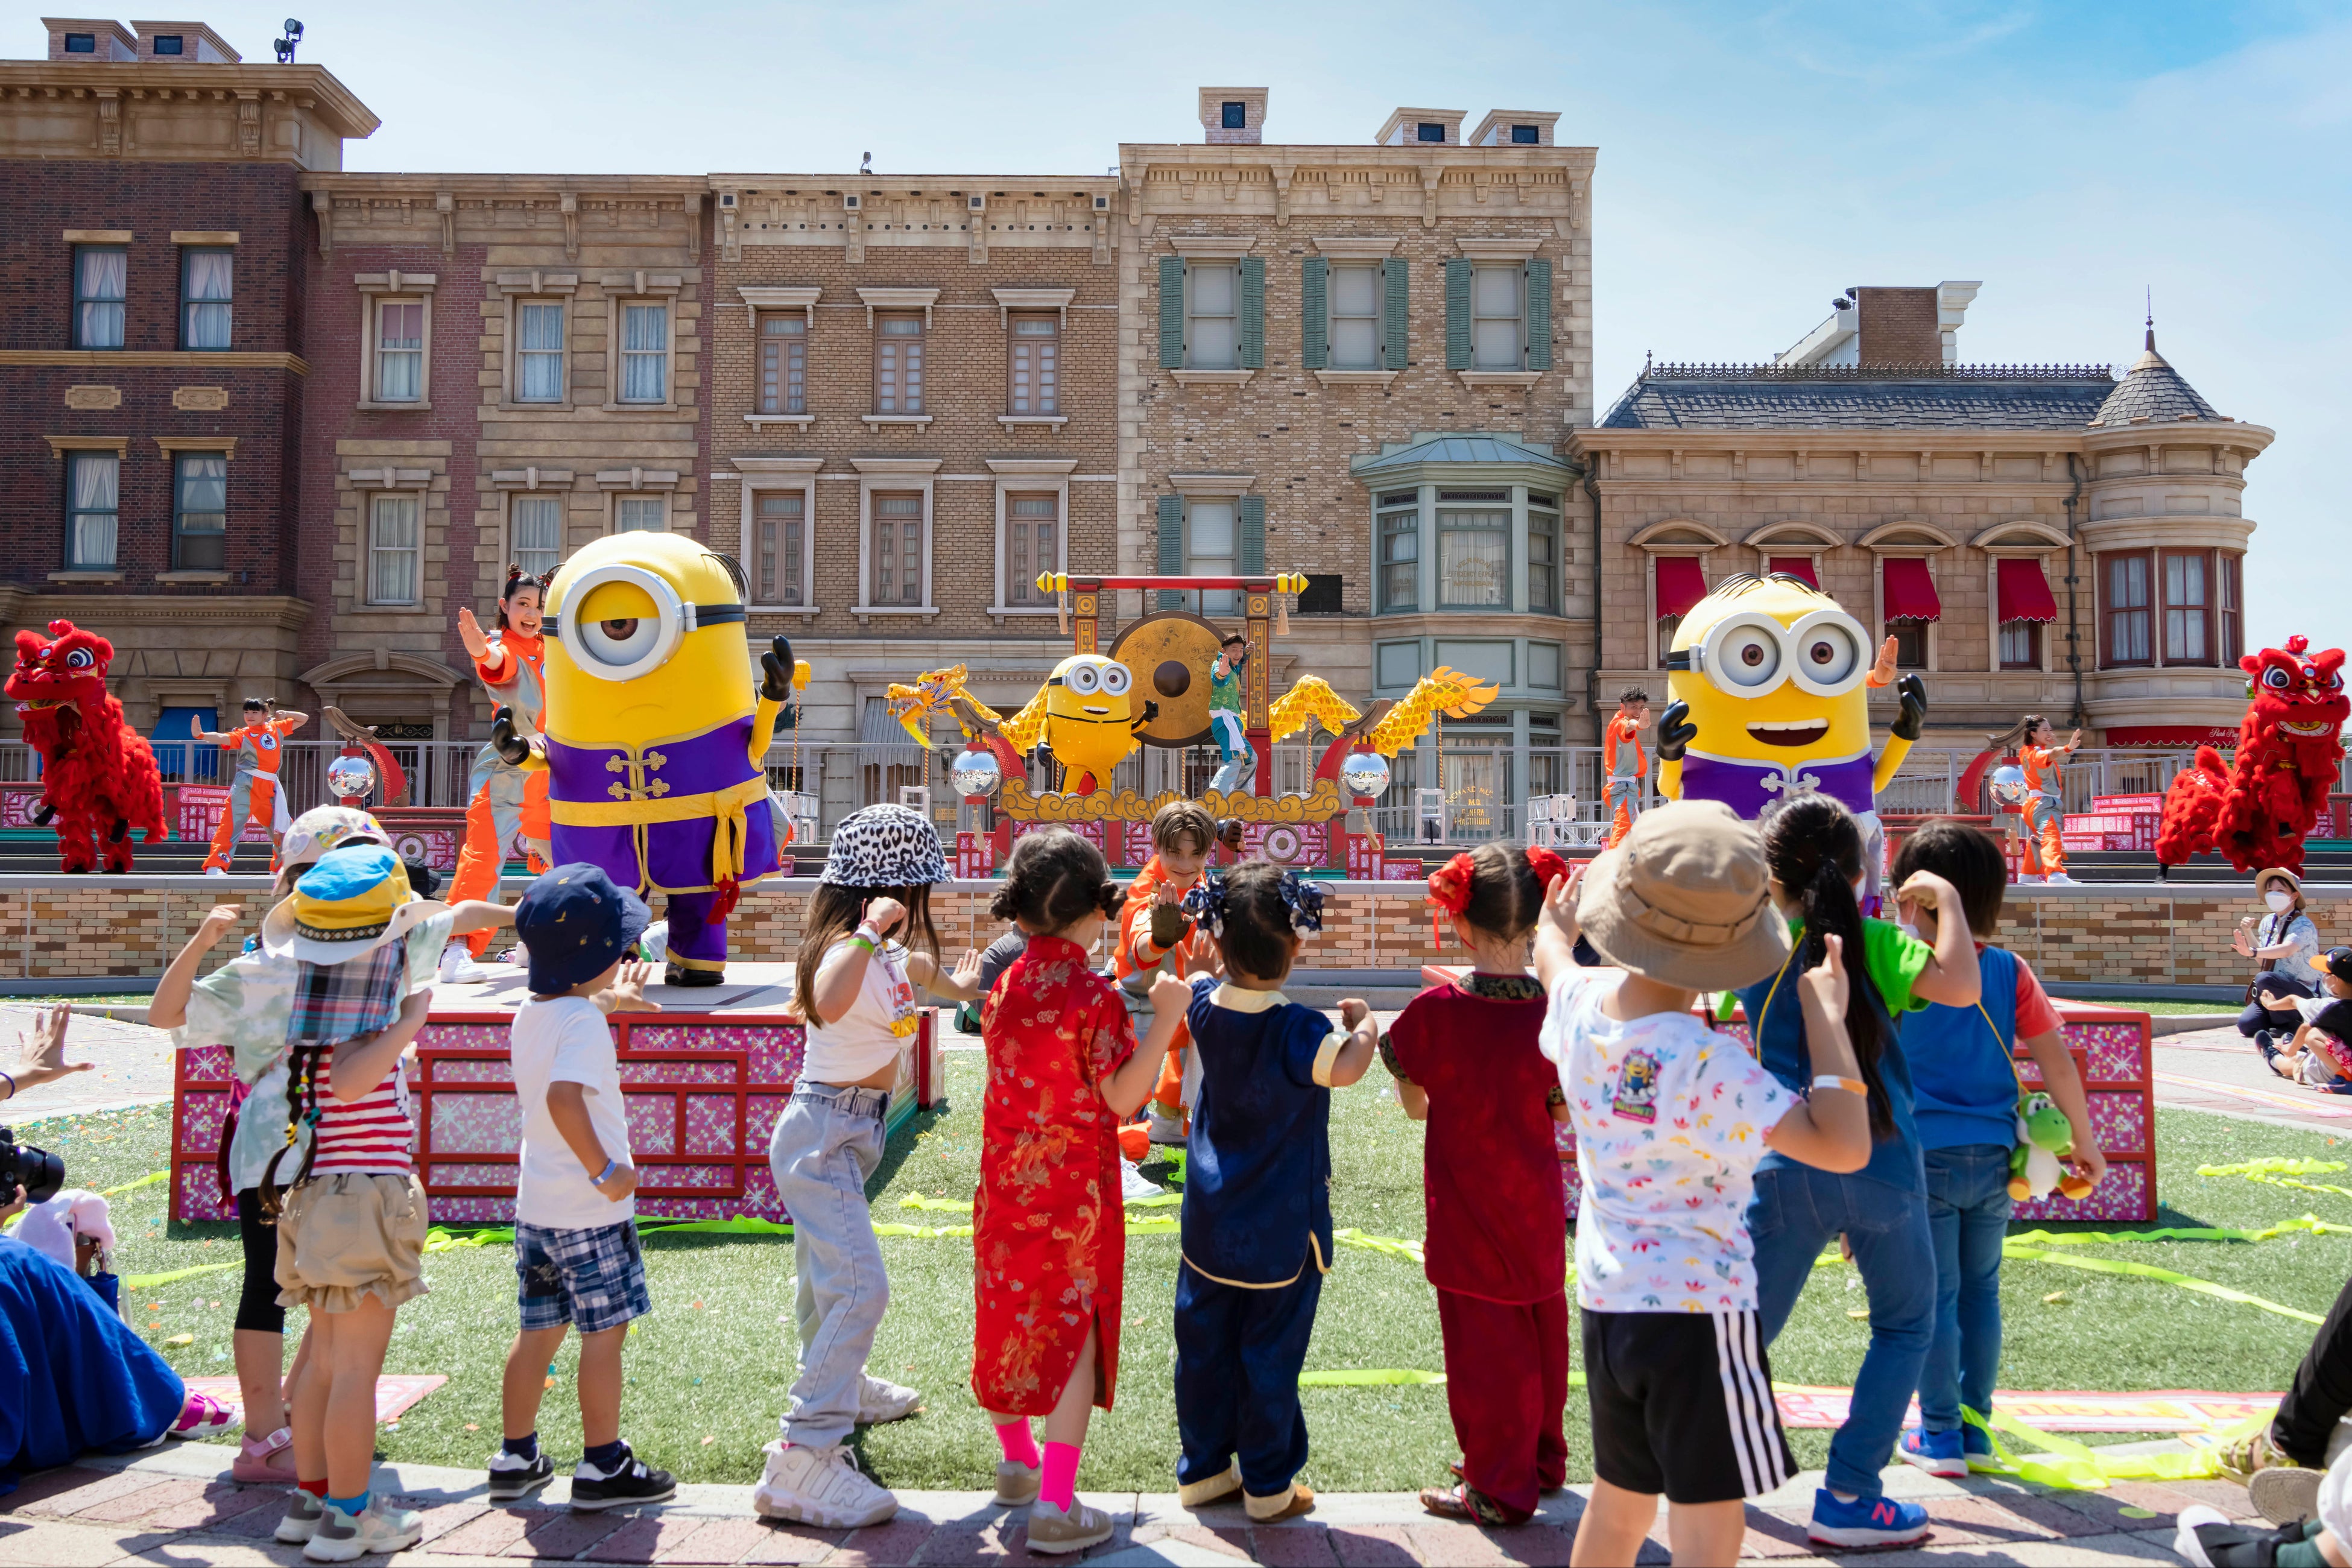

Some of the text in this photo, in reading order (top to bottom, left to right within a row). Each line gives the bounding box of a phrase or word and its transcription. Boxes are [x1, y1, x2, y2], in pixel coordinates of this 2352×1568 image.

[1456, 557, 1491, 569] VERNON
[2209, 728, 2226, 737] Park
[1909, 1434, 1920, 1450] N
[632, 1462, 648, 1478] N
[1080, 1507, 1093, 1528] N
[1871, 1502, 1895, 1525] N
